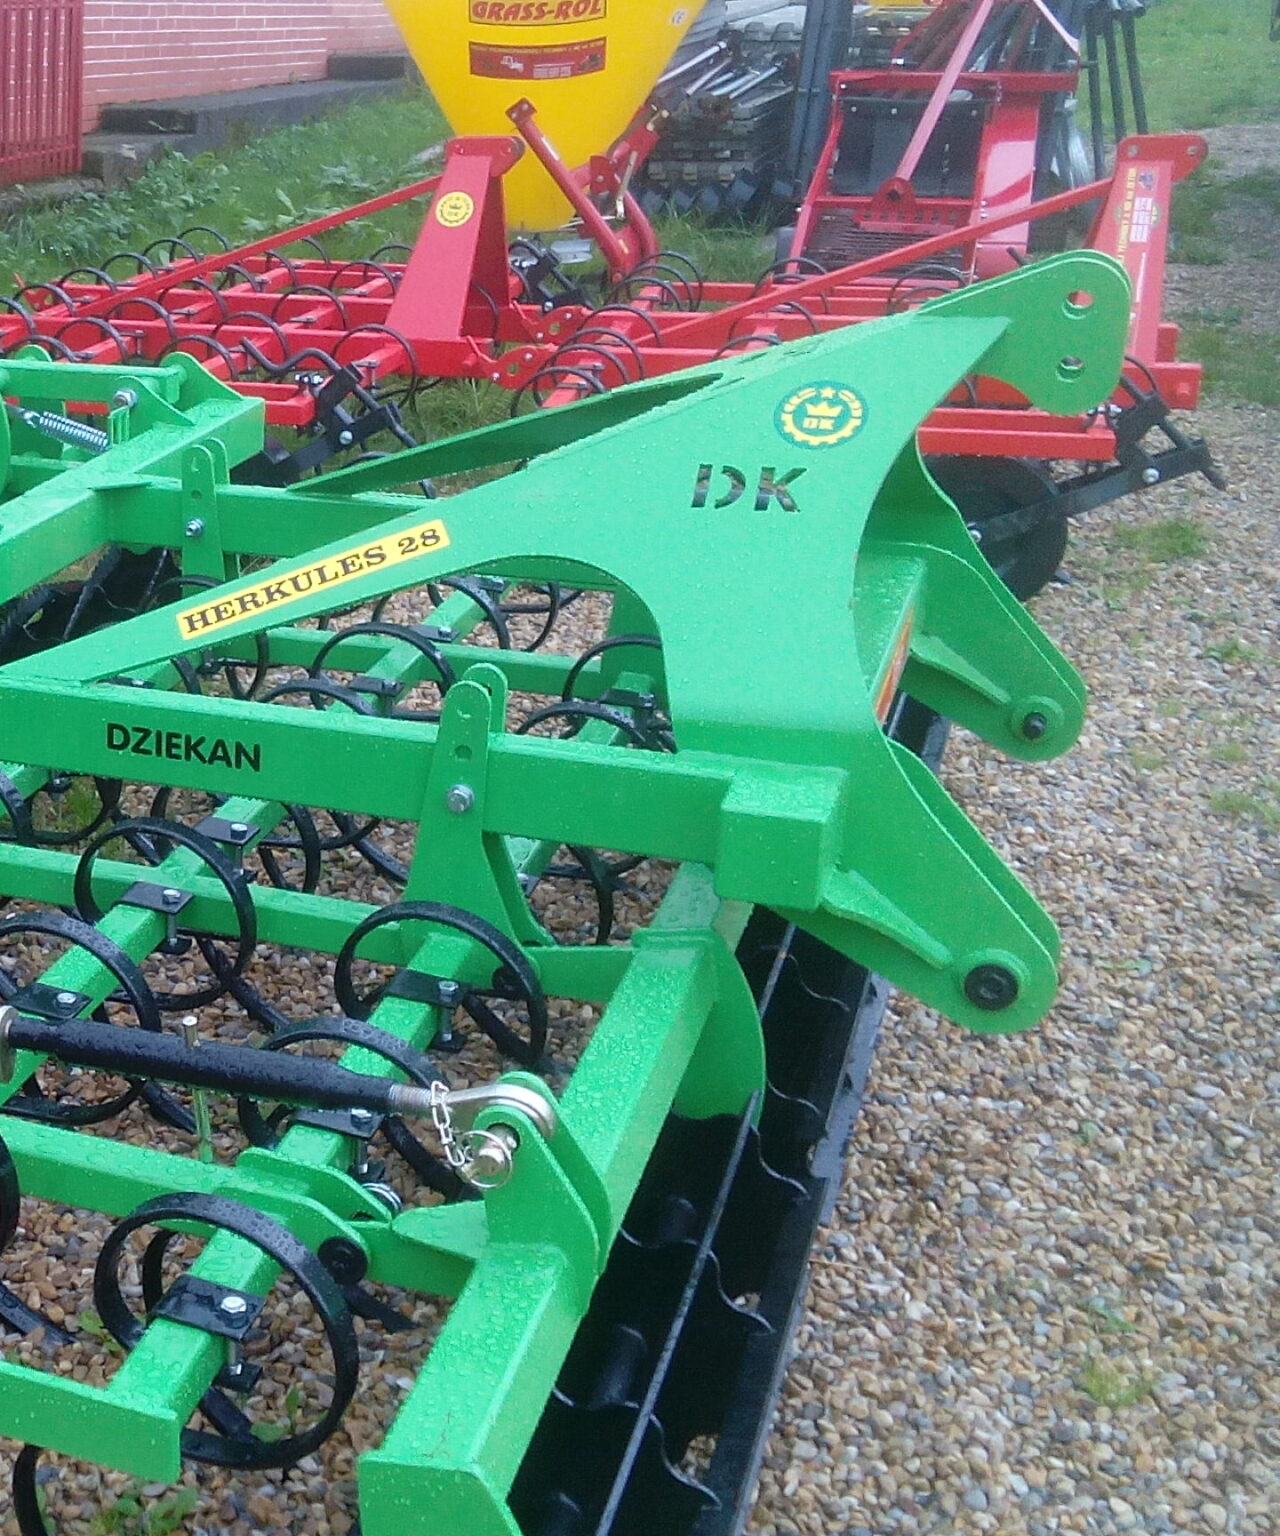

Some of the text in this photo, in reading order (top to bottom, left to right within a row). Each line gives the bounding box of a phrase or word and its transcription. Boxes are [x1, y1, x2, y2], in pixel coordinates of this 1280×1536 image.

[472, 0, 601, 21] GRASS-ROL
[802, 416, 836, 431] DK
[690, 463, 807, 513] DK
[182, 527, 442, 634] HERKULES 28
[106, 722, 261, 772] DZIEKAN
